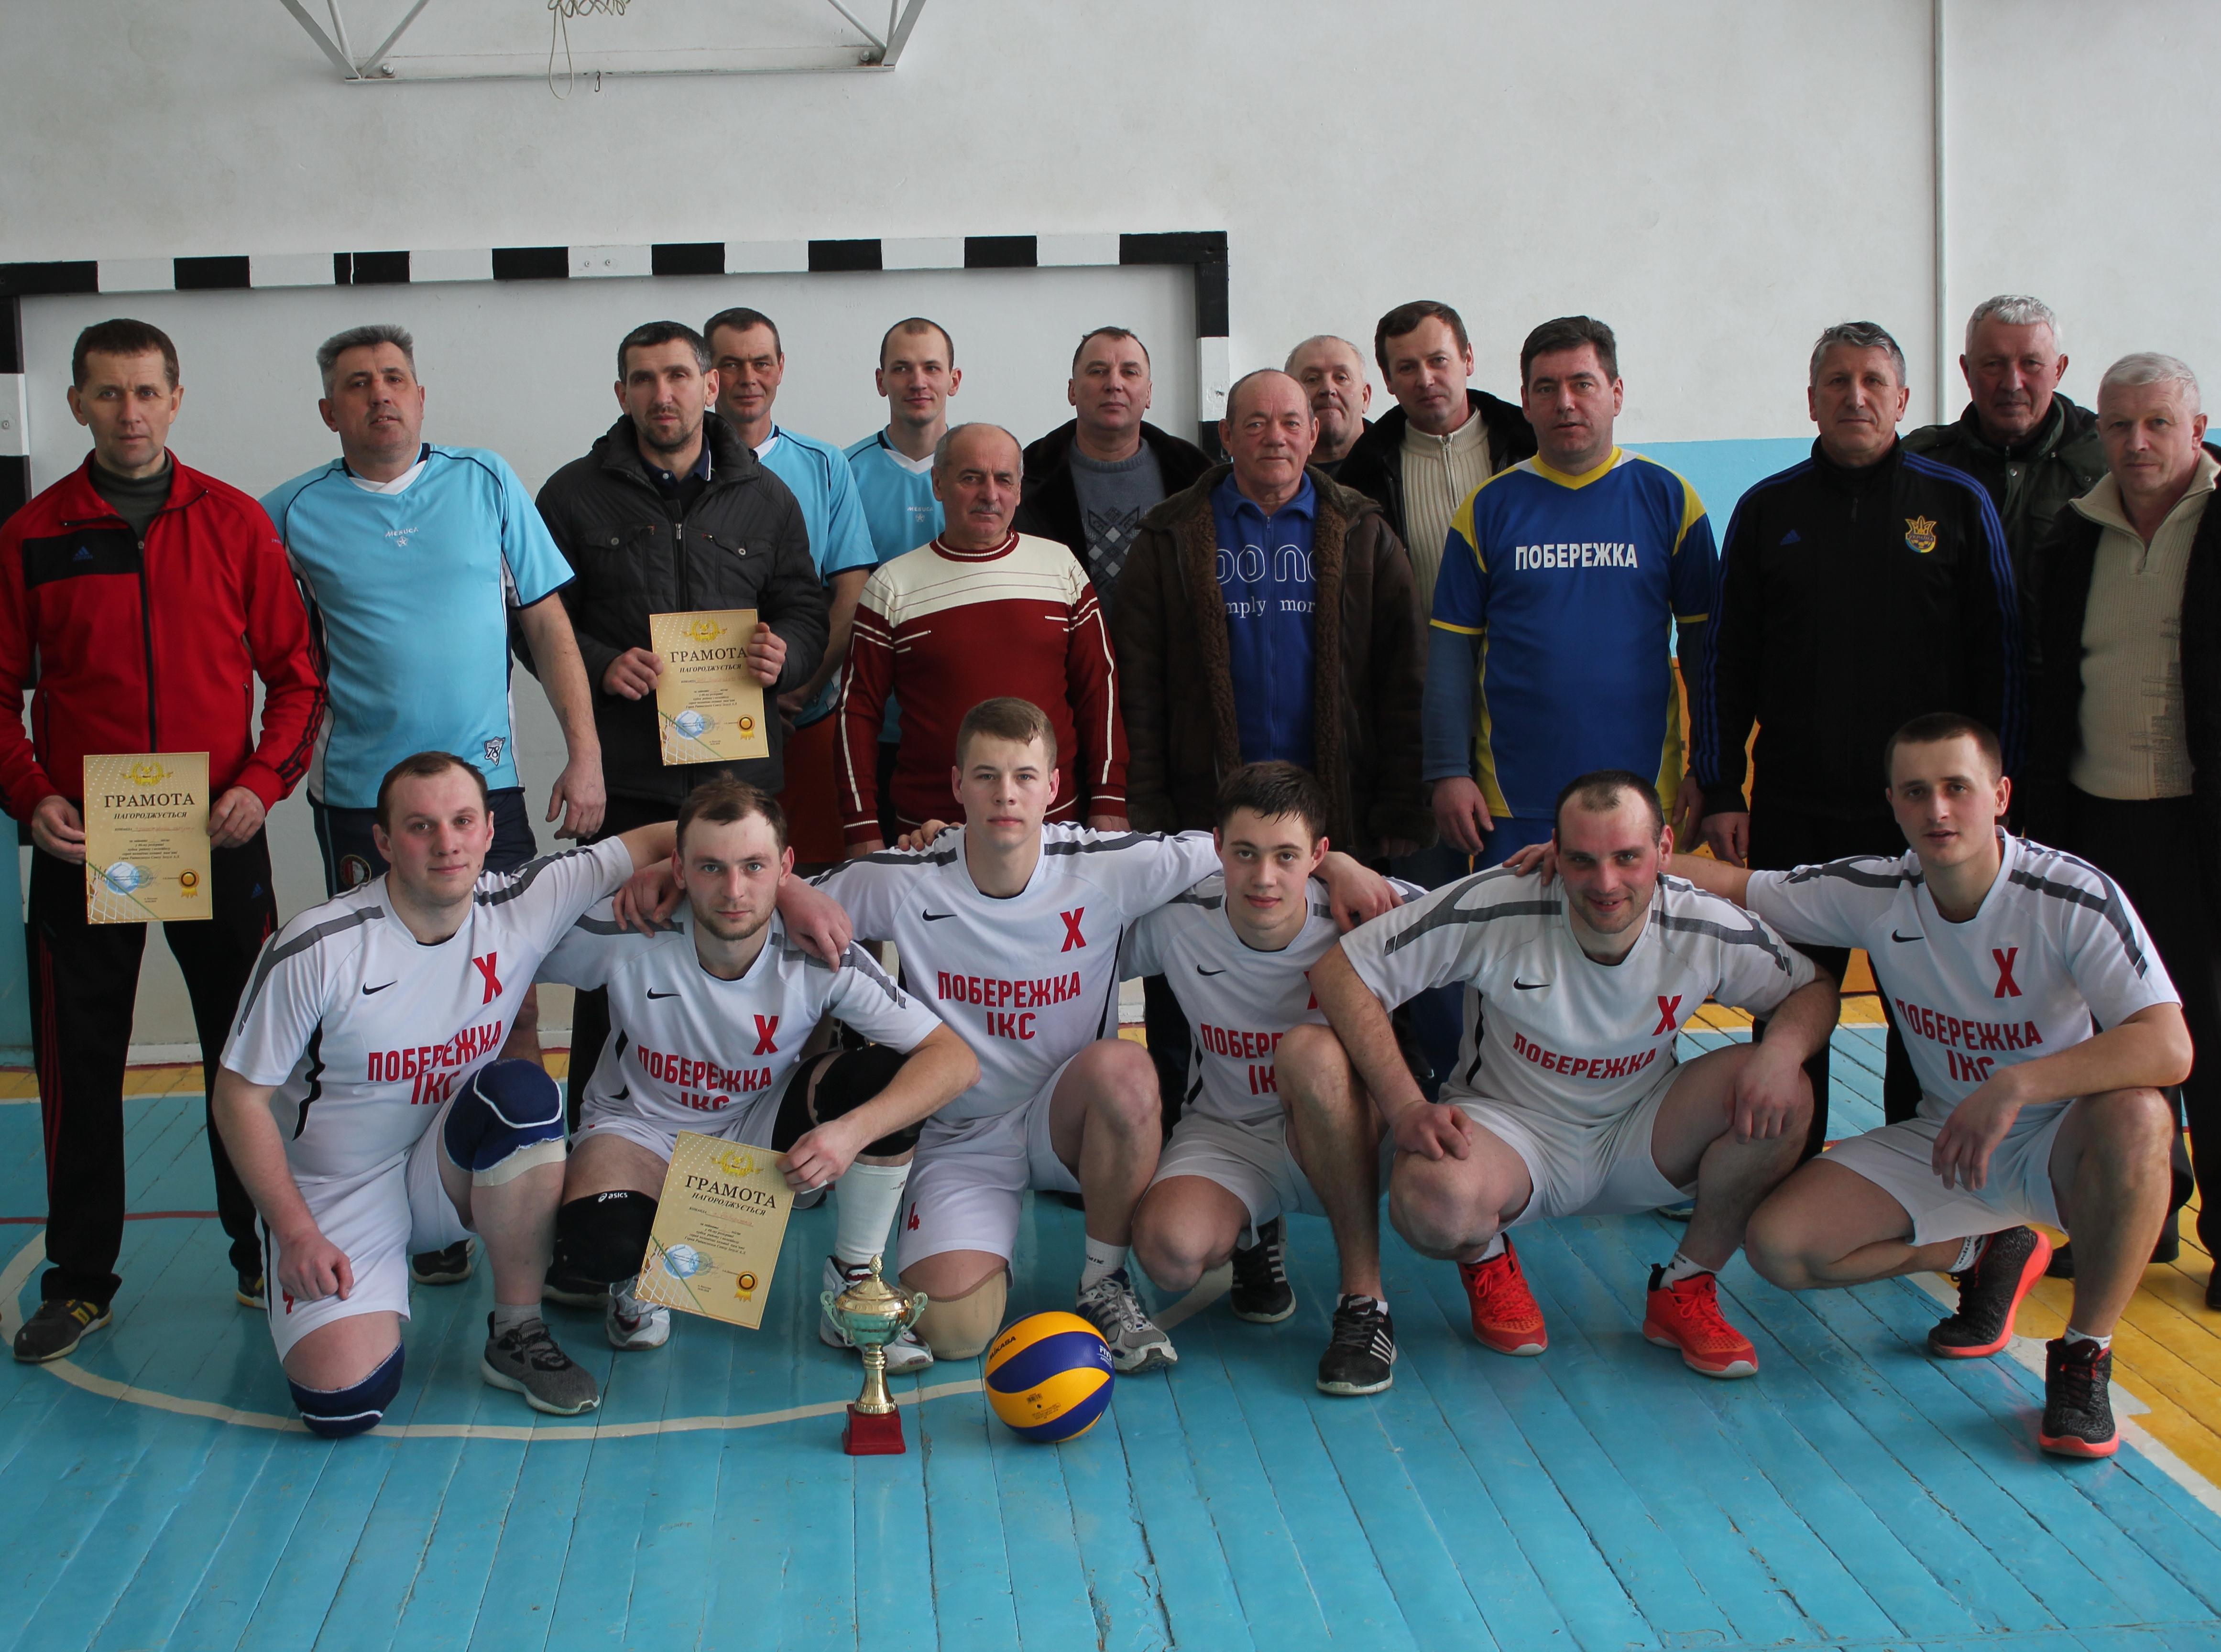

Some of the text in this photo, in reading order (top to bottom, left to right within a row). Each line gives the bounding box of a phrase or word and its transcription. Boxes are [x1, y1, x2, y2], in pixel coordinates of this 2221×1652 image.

[385, 527, 419, 538] MESUCA
[1515, 543, 1638, 571] ПОБЕРЕЖКА
[670, 647, 748, 663] ГРАМОТА
[679, 664, 742, 674] НАГОРОДЖУЄТЬСЯ
[487, 746, 500, 758] 78
[104, 793, 195, 808] ГРАМОТА
[114, 812, 187, 820] НАГОРОДЖУЄТЬСЯ
[938, 971, 1081, 1008] ПОБЕРЕЖКА
[1895, 998, 2043, 1051] ПОБЕРЕЖКА
[368, 1020, 502, 1082] ПОБЕРЕЖКА
[1201, 1023, 1284, 1059] ПОБЕР
[1513, 1032, 1656, 1079] ПОБЕРЕЖКА
[637, 1044, 772, 1093] ПОБЕРЕЖКА
[1248, 1065, 1278, 1096] ІК
[685, 1175, 777, 1208] ГРАМОТА
[691, 1193, 766, 1216] НАГОРОДЖУЄТЬСЯ
[908, 1201, 920, 1231] 4
[989, 1336, 1017, 1363] MIKASA
